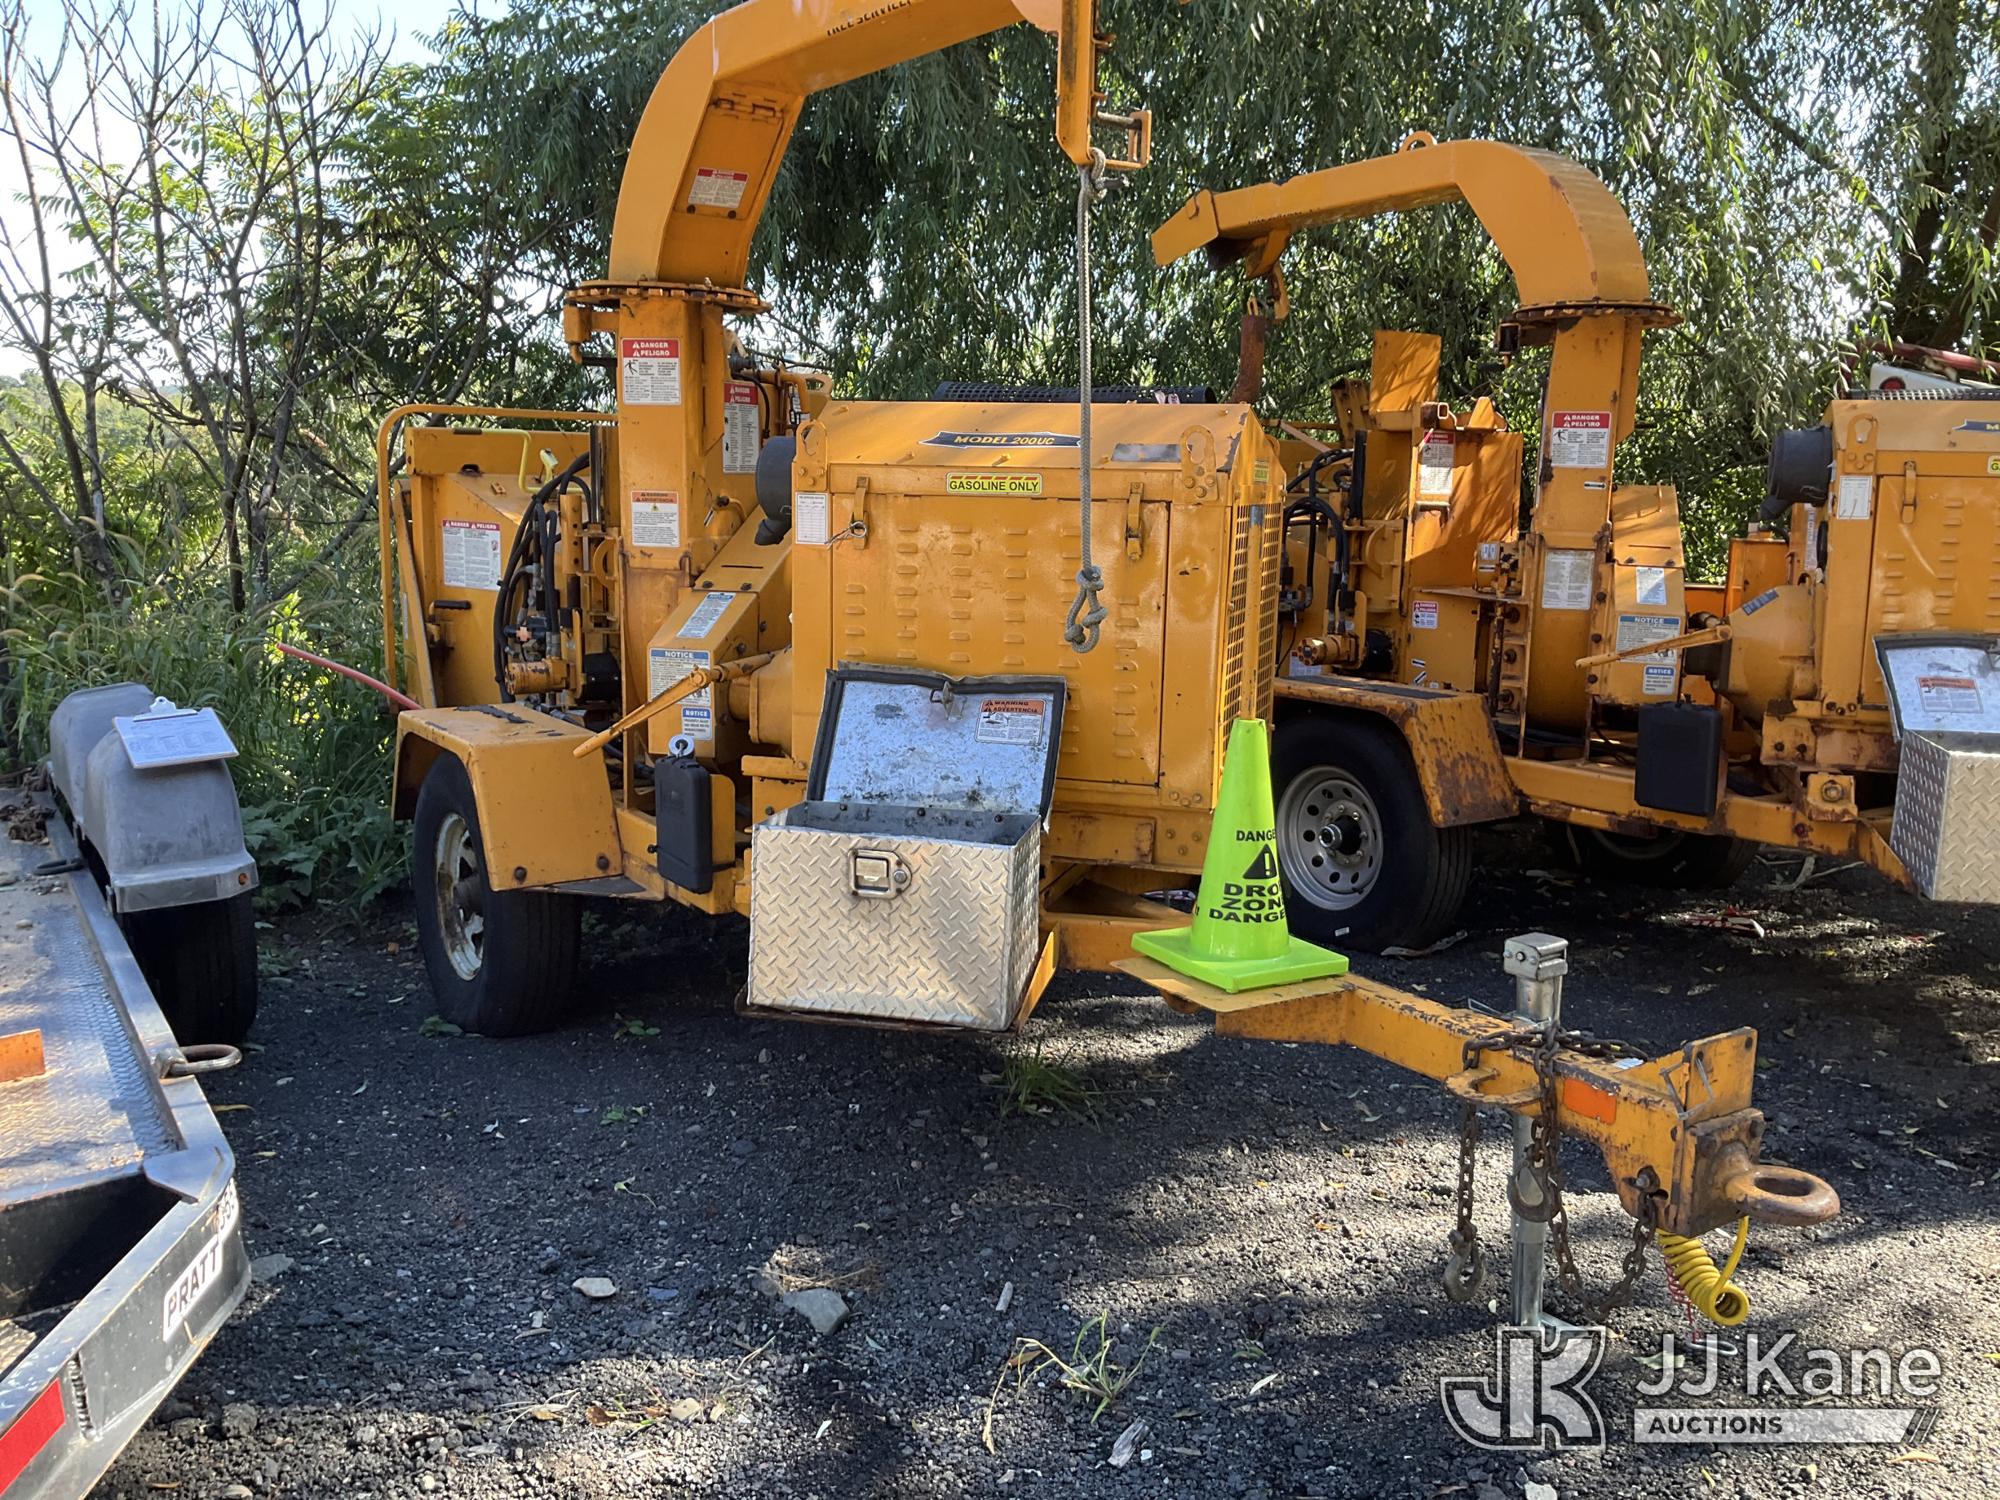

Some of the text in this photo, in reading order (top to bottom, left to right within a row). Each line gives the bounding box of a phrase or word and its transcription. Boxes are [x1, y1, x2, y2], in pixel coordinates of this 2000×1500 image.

[640, 349, 670, 357] PELIGRO
[954, 436, 1056, 445] MODEL 200UC
[949, 480, 1039, 492] GASOLINE ONLY
[664, 651, 694, 659] NOTICE
[685, 709, 708, 717] NOTICE
[1224, 881, 1281, 897] DRO
[1220, 897, 1284, 911] ZON
[167, 1241, 219, 1329] PRATT
